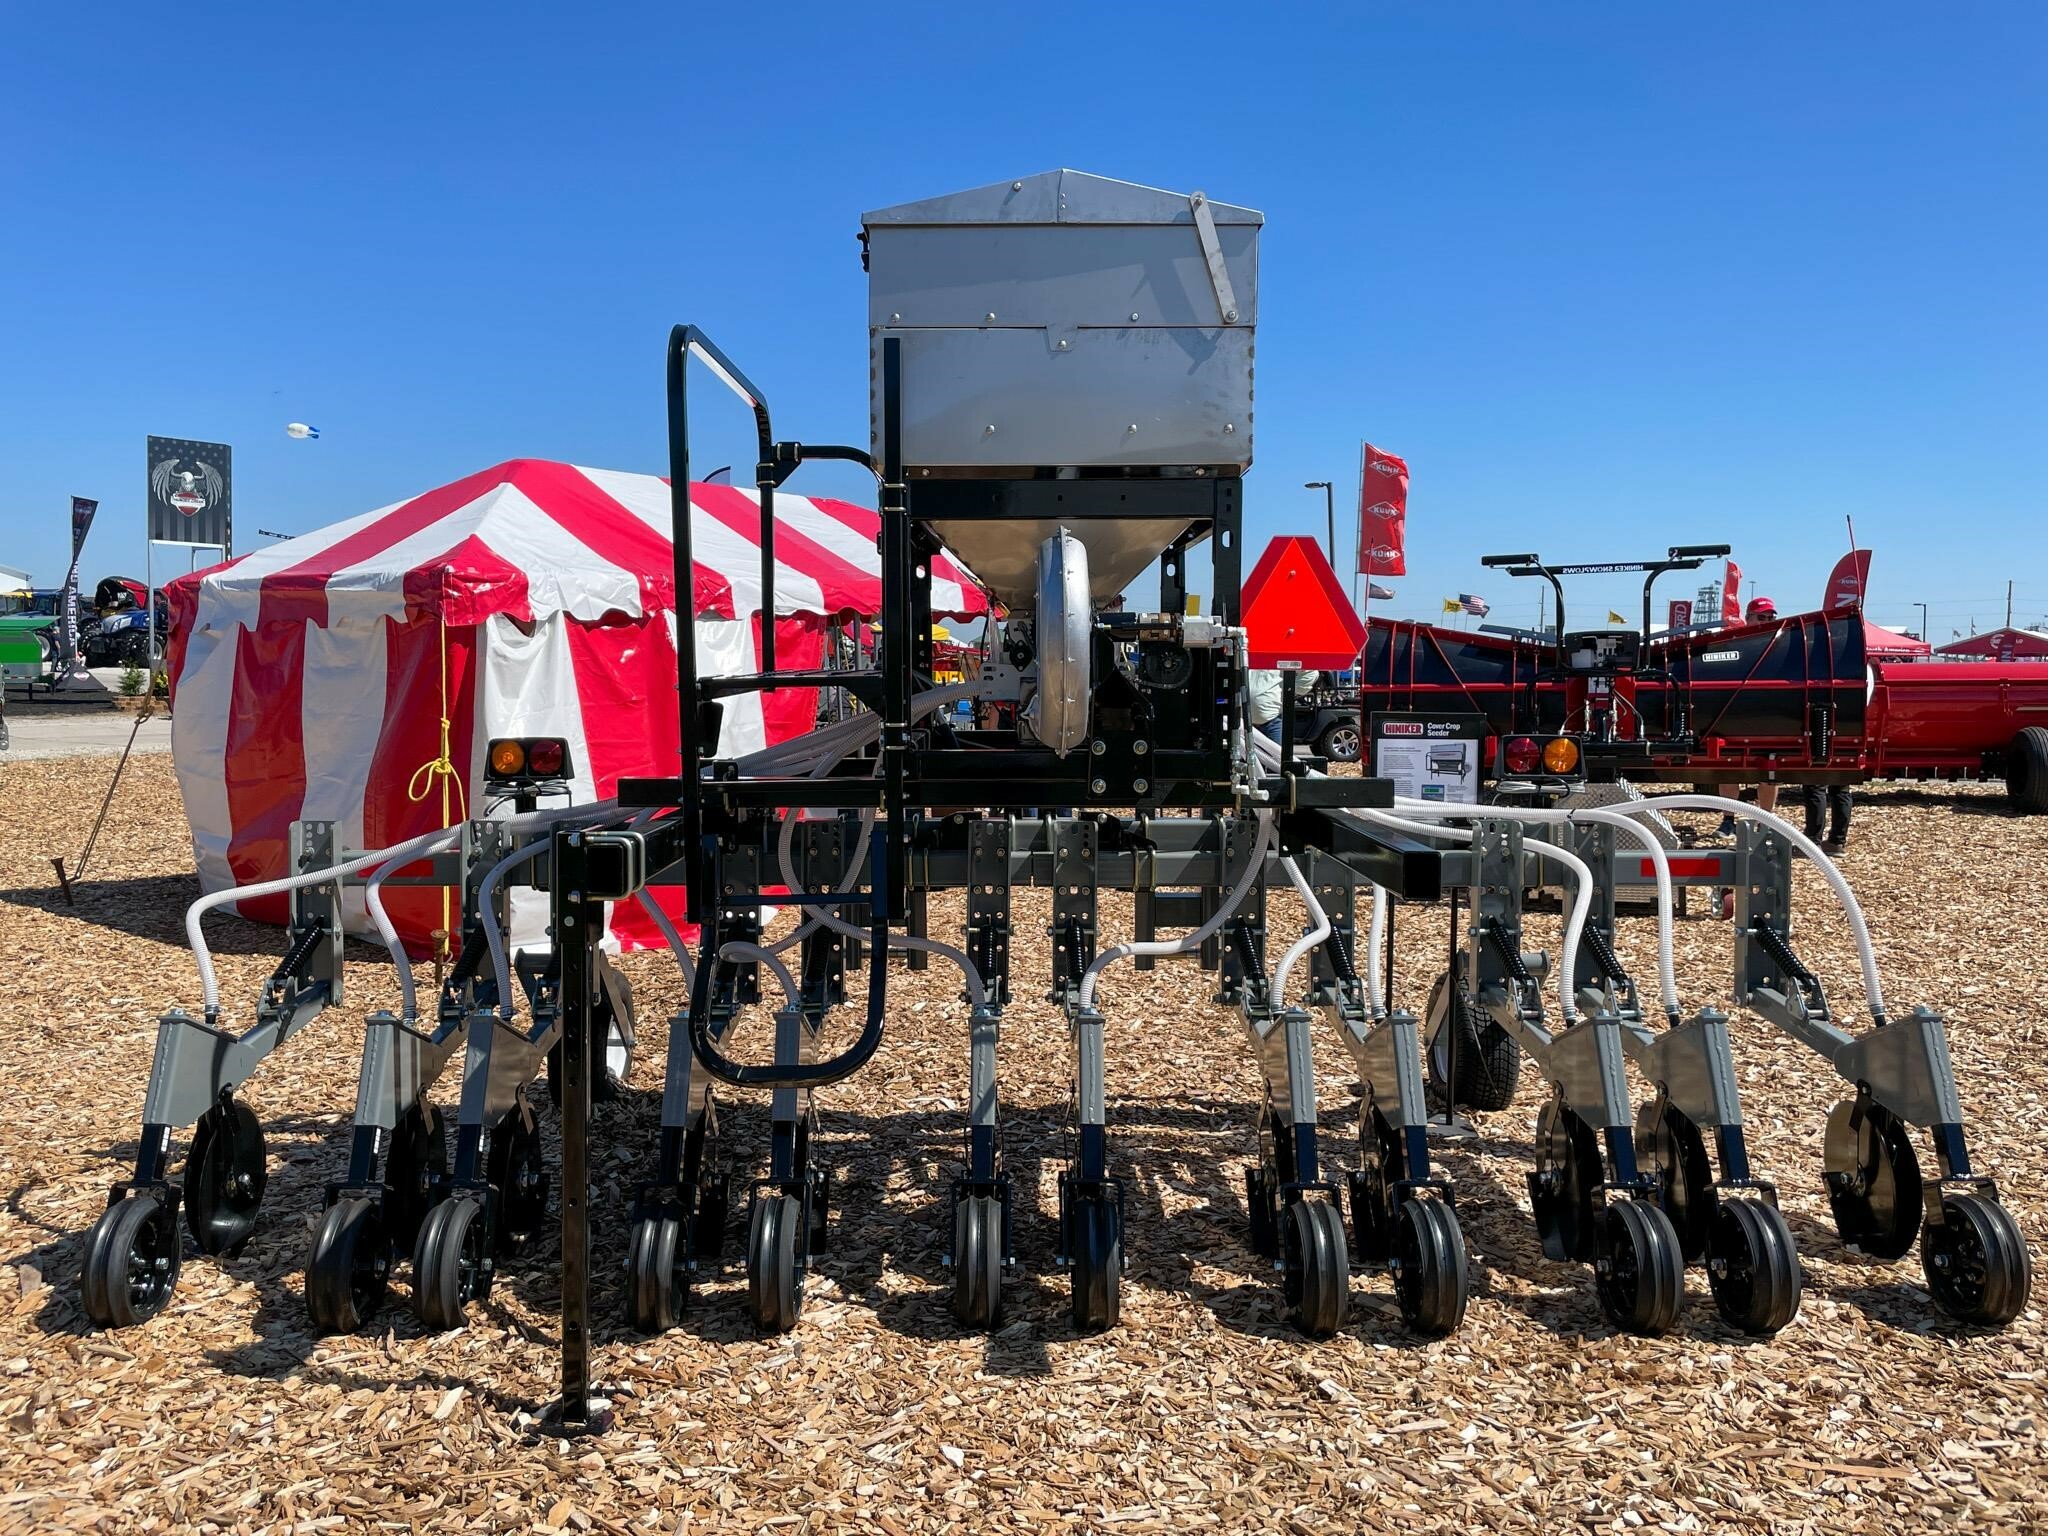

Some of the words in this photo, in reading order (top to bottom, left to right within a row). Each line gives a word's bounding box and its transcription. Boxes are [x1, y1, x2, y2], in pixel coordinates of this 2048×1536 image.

[1375, 463, 1400, 474] KUHN
[67, 585, 77, 647] AMERICA
[1385, 724, 1422, 734] HINIKER
[1445, 722, 1461, 731] Crop
